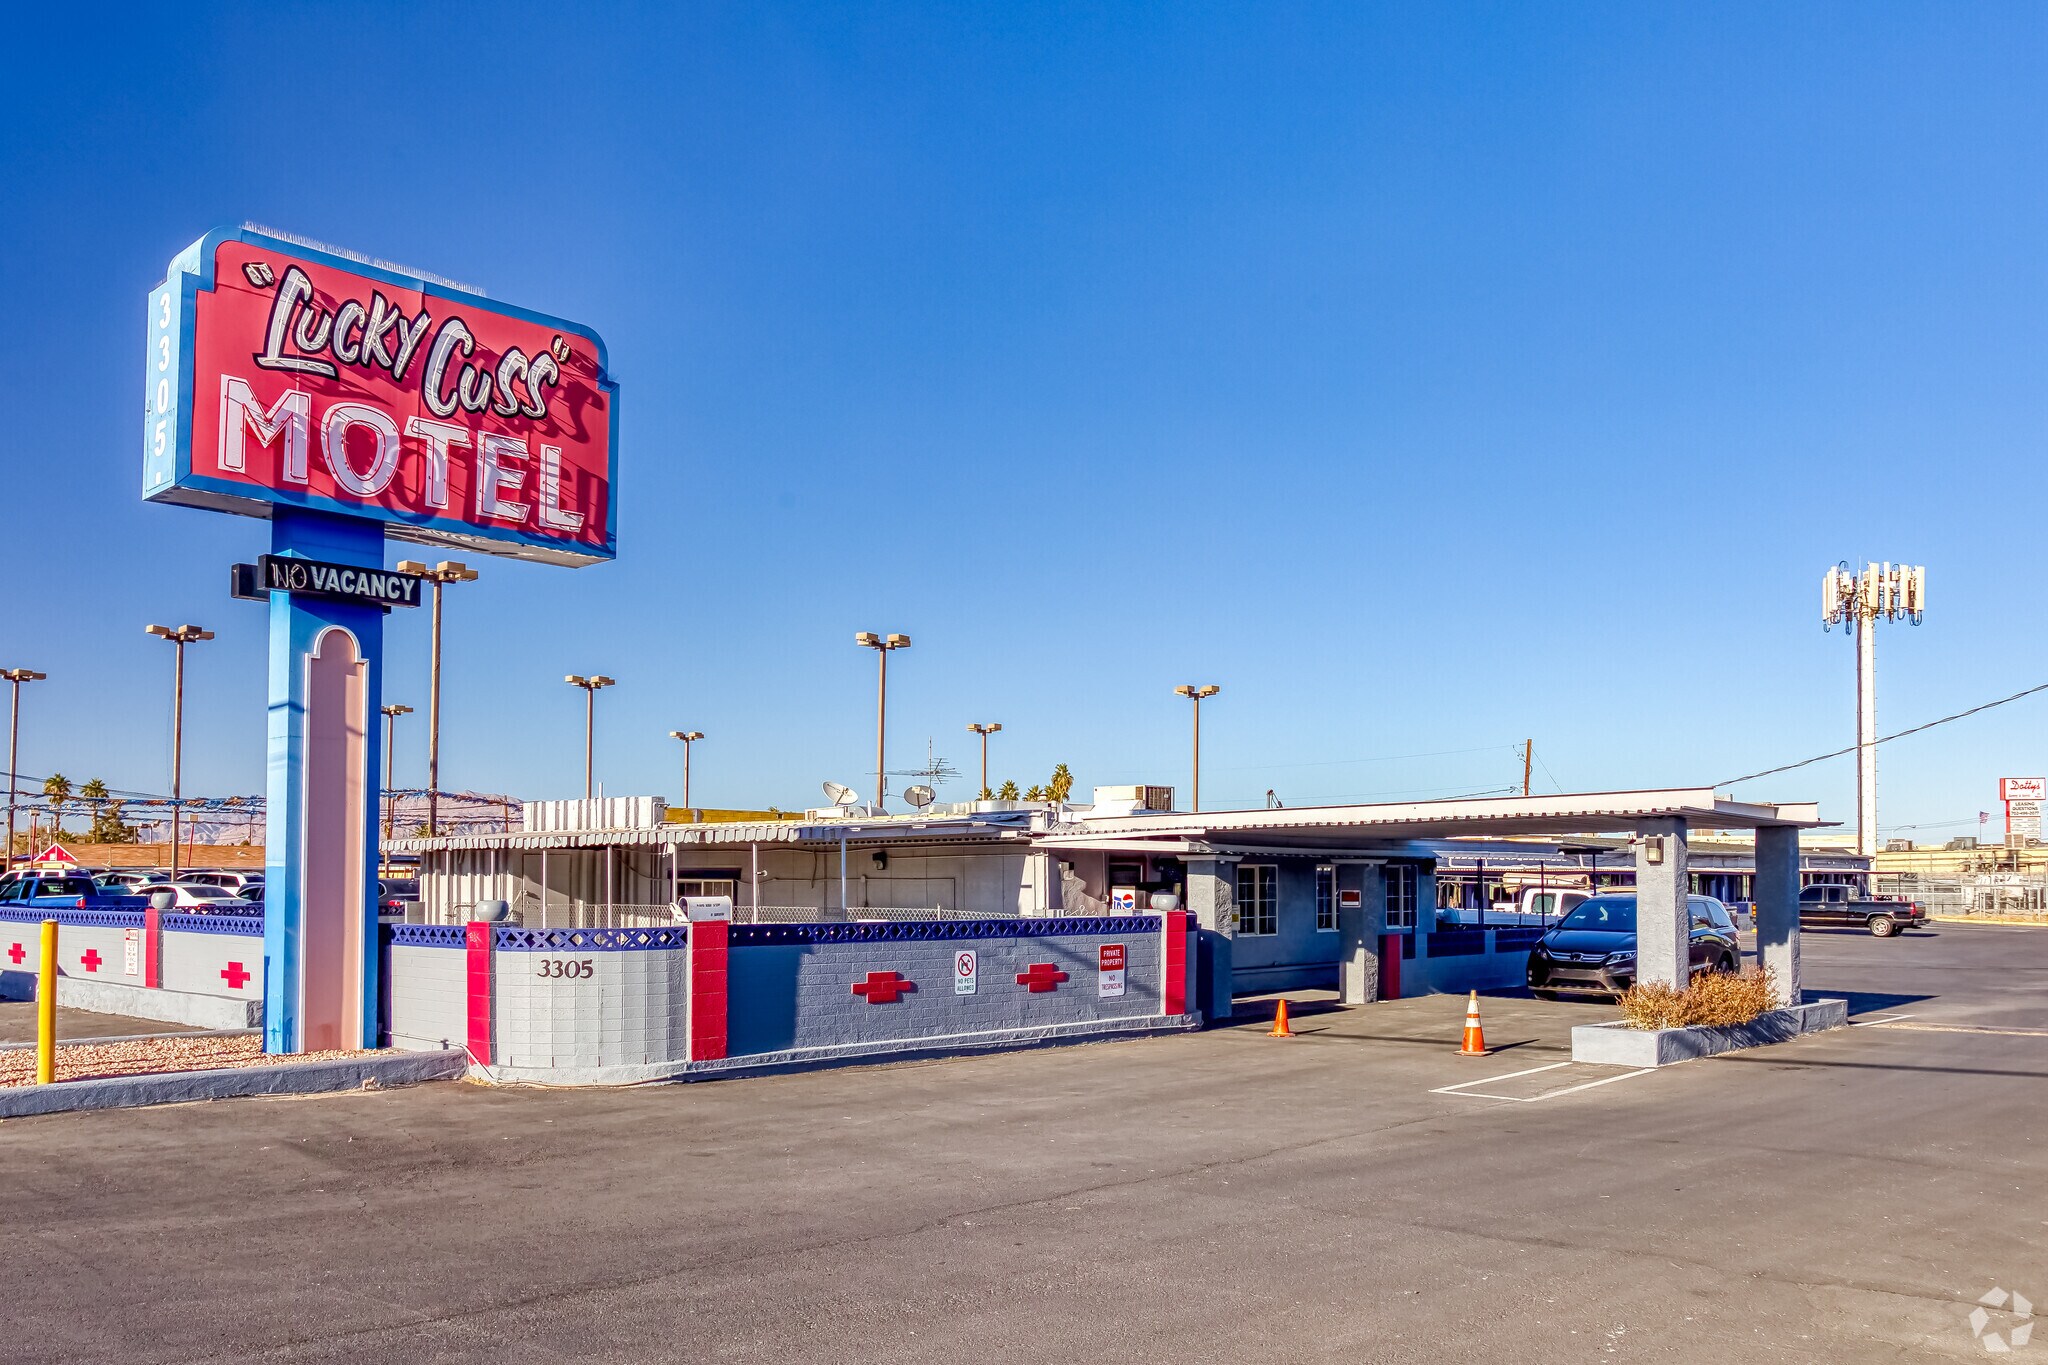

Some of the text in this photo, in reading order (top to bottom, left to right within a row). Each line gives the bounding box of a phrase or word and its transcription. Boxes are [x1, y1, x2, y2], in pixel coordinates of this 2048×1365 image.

[154, 292, 171, 457] 3305
[218, 374, 586, 533] MOTEL
[271, 563, 416, 601] NO VACANCY
[1101, 958, 1123, 966] PROPERTY
[1103, 949, 1121, 957] PRIVATE
[537, 959, 593, 979] 3305
